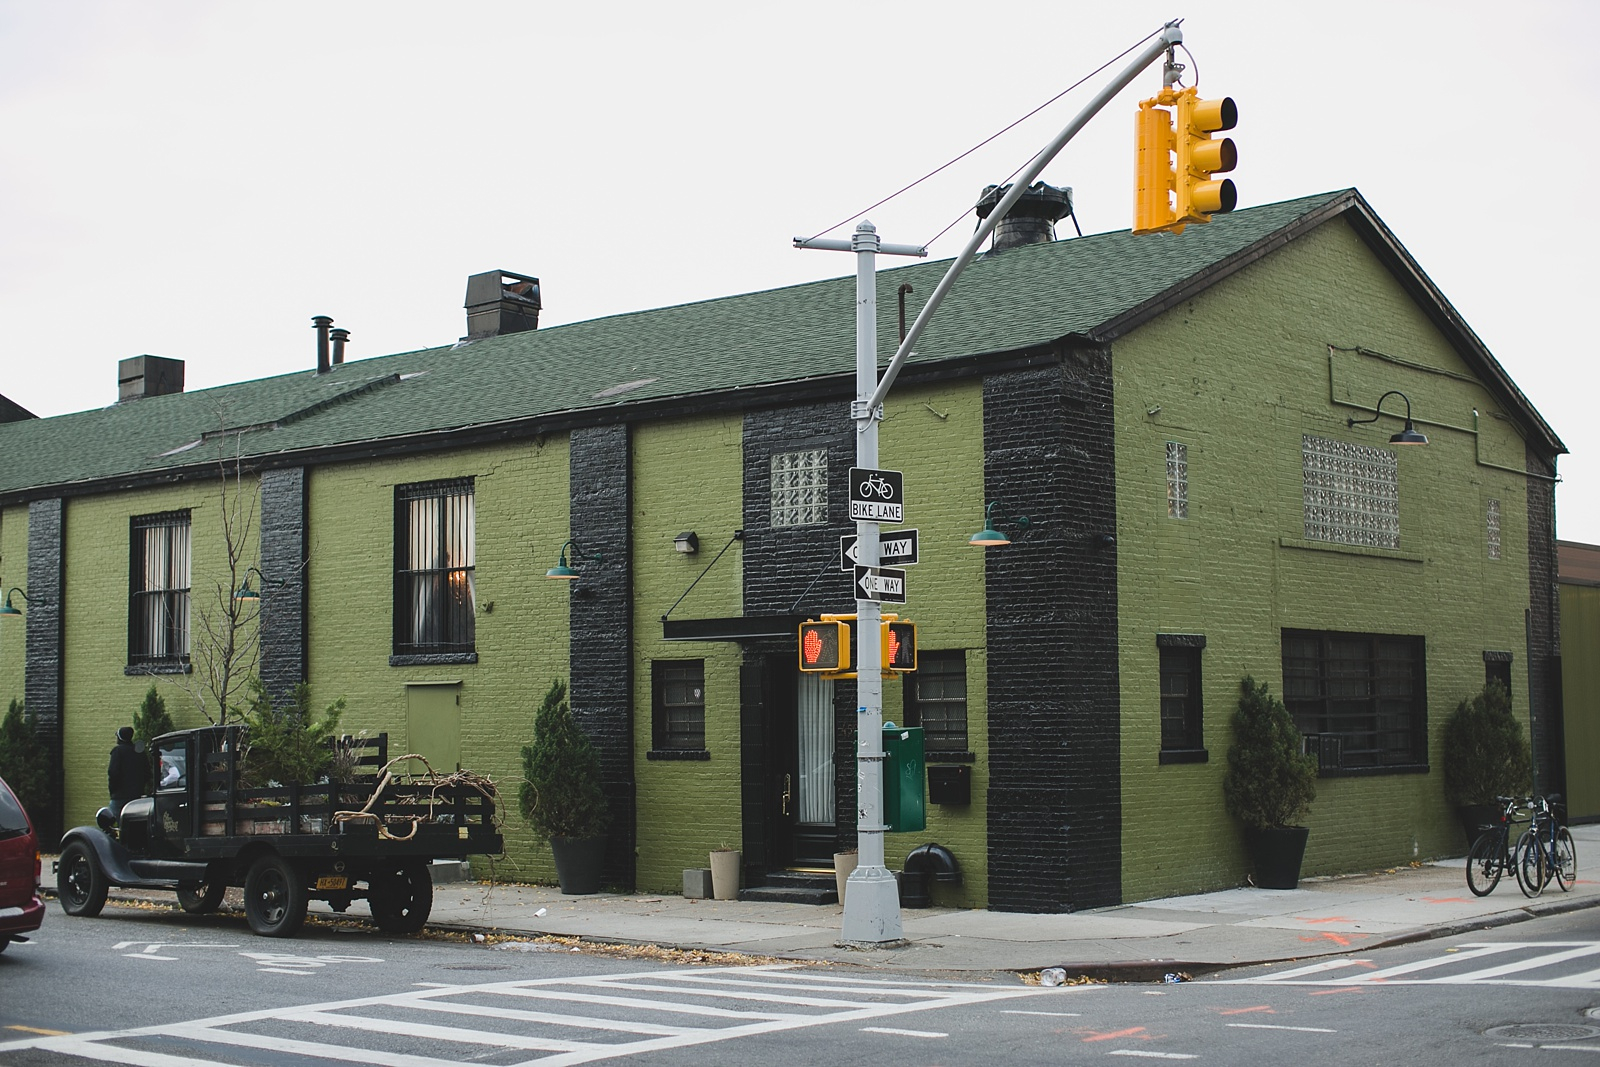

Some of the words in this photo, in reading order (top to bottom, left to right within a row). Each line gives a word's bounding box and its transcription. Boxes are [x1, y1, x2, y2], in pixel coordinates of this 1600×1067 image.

[852, 503, 873, 516] BIKE
[877, 505, 900, 518] LANE
[884, 541, 907, 555] WAY
[864, 576, 878, 590] ONE
[883, 579, 899, 592] WAY
